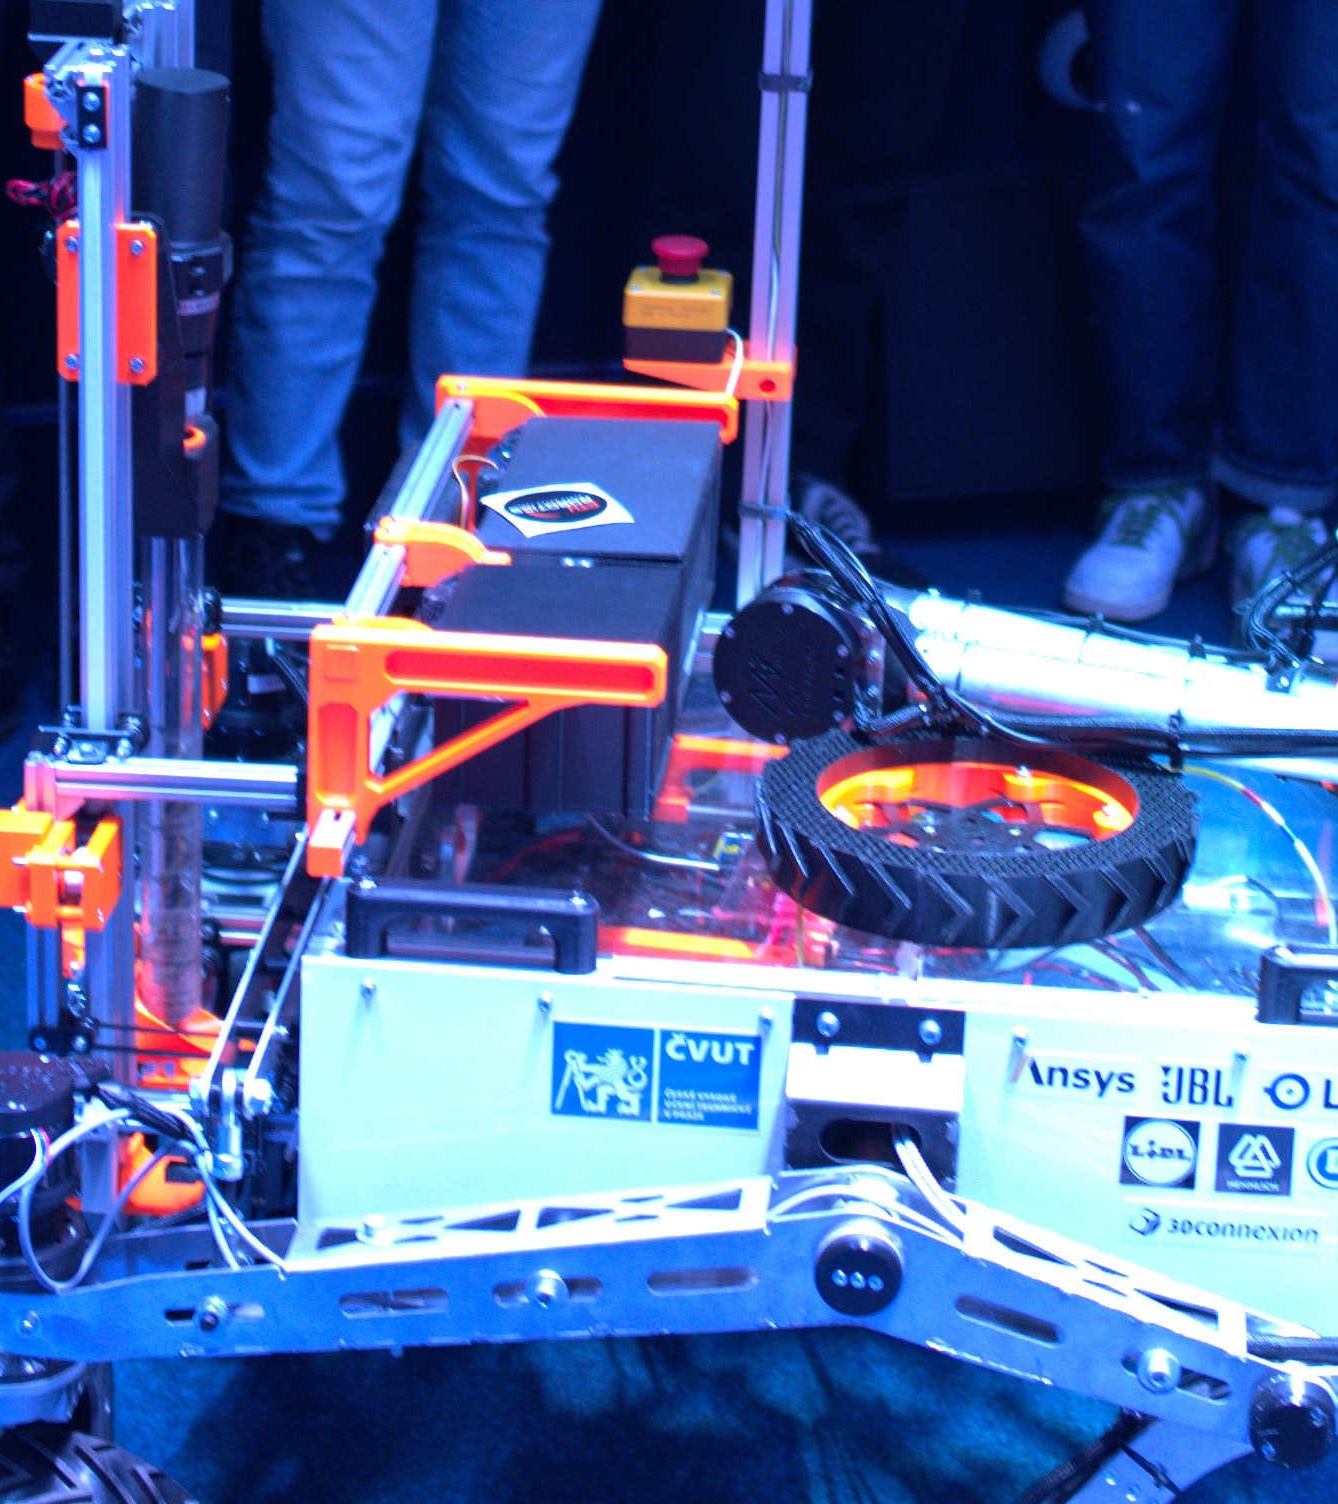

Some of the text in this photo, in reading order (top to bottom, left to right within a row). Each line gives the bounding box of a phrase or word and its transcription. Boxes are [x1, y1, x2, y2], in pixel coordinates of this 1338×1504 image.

[665, 1032, 755, 1066] ČVUT
[1011, 1056, 1136, 1098] Ansys
[1161, 1065, 1234, 1109] JBL
